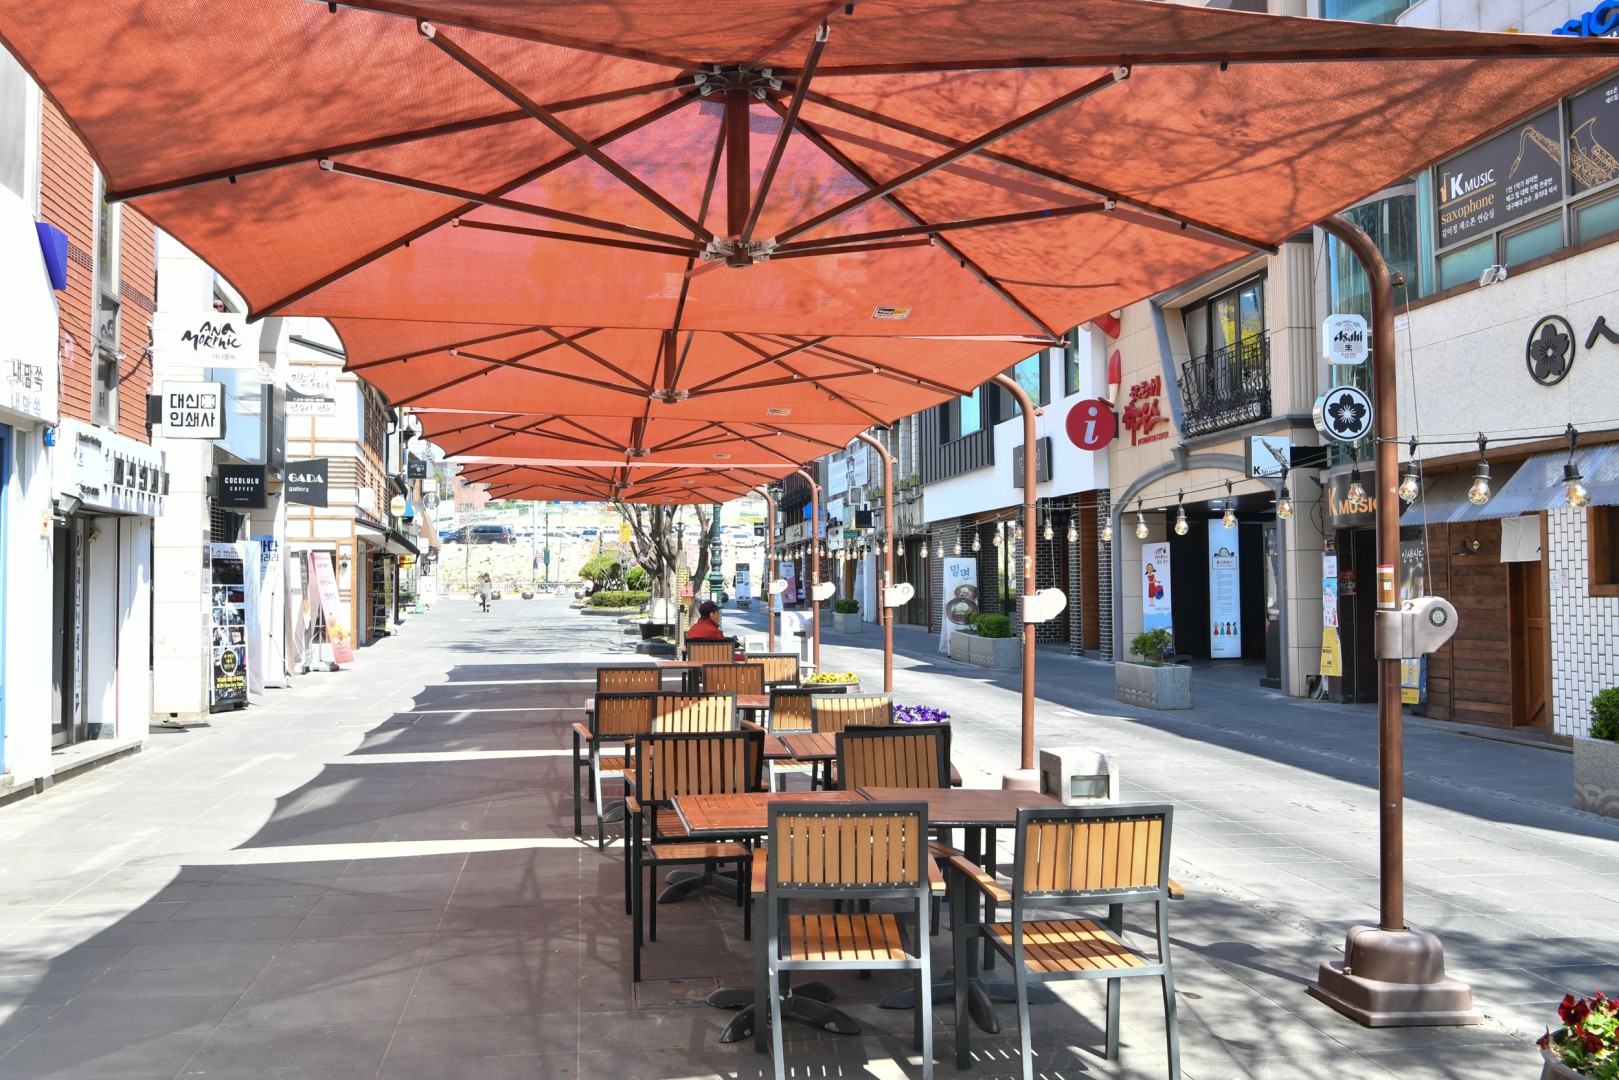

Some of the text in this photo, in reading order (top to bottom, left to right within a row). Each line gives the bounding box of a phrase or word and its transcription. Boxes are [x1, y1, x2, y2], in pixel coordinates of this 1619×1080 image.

[1451, 169, 1495, 199] K MUSIC
[1441, 193, 1495, 226] saxophone
[1334, 330, 1363, 342] Asahi
[170, 393, 199, 409] 대신
[170, 411, 216, 427] 인쇄사
[288, 472, 324, 483] GADA
[1253, 465, 1261, 475] K
[224, 477, 259, 485] COCOLULU
[1328, 487, 1339, 517] K
[950, 564, 970, 580] 밀면
